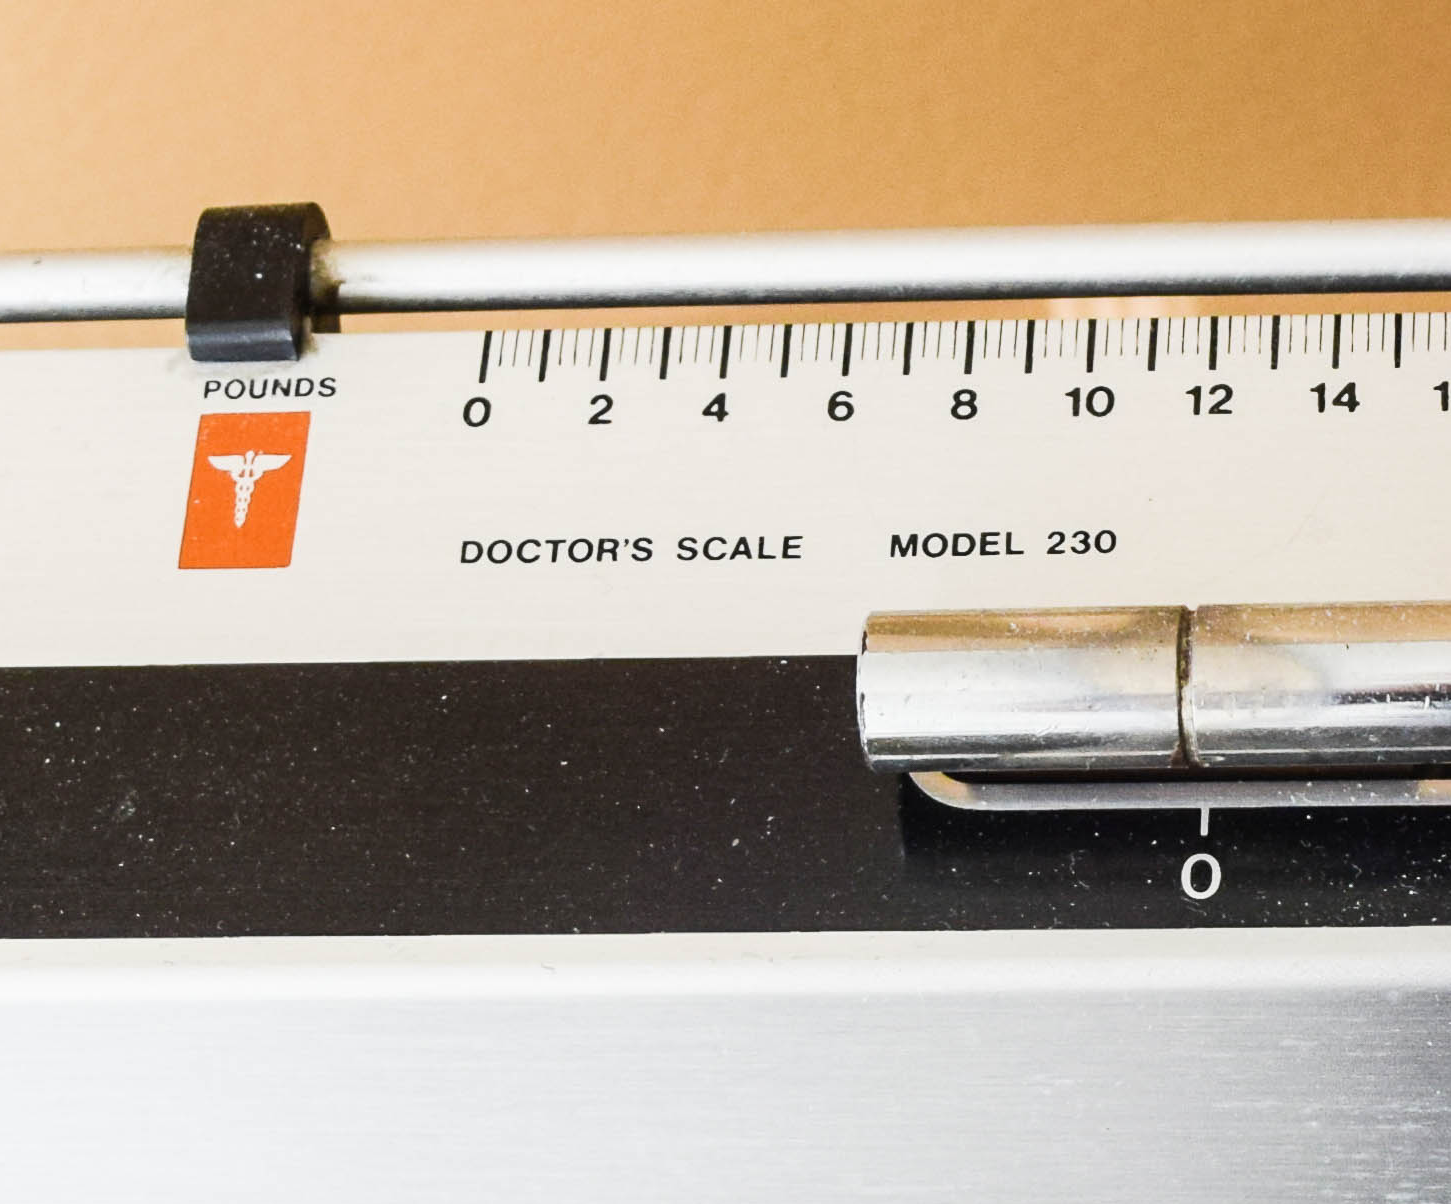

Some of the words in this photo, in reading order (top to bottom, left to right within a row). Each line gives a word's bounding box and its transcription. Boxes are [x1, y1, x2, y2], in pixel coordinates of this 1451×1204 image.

[202, 375, 338, 401] POUNDS
[461, 395, 493, 429] 0
[586, 392, 615, 426] 2
[700, 391, 730, 424] 4
[826, 389, 856, 423] 6
[949, 387, 979, 422] 8
[1063, 384, 1116, 419] 10
[1184, 382, 1235, 417] 12
[1308, 380, 1362, 415] 14
[459, 536, 655, 566] DOCTOR'S
[675, 534, 805, 562] SCALE
[889, 530, 1026, 560] MODEL
[1045, 528, 1118, 556] 230
[1179, 852, 1223, 901] 0
